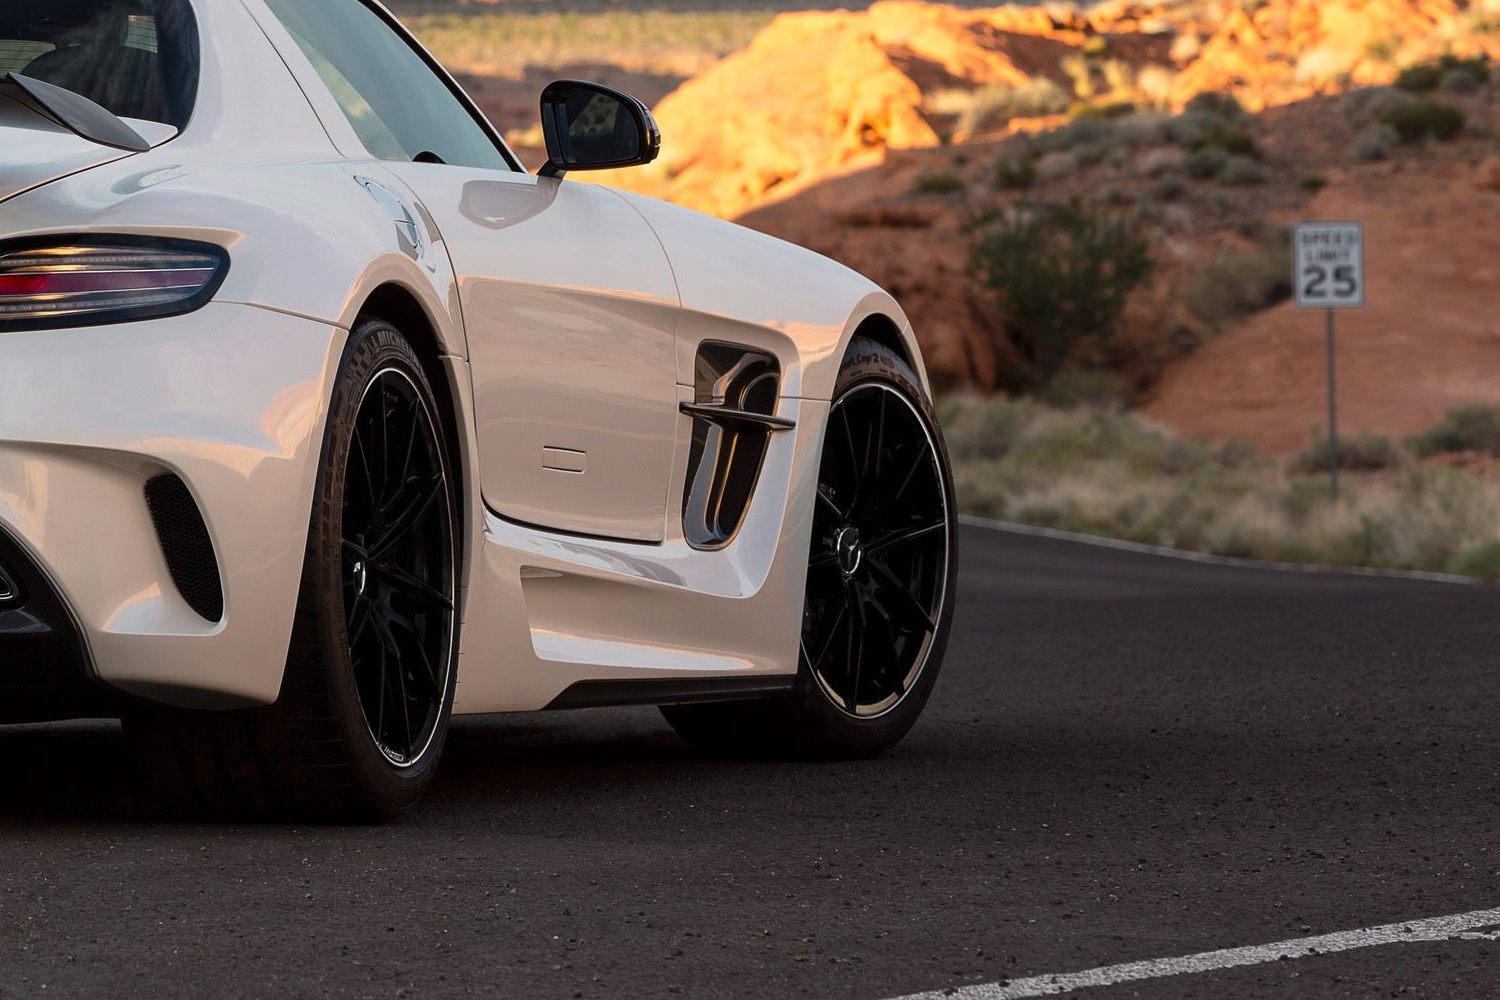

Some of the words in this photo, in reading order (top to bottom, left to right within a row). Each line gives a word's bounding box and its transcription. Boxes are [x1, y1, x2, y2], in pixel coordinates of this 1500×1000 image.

[1302, 232, 1358, 246] SPEED
[1305, 249, 1351, 262] LIMIT
[1303, 266, 1357, 298] 25
